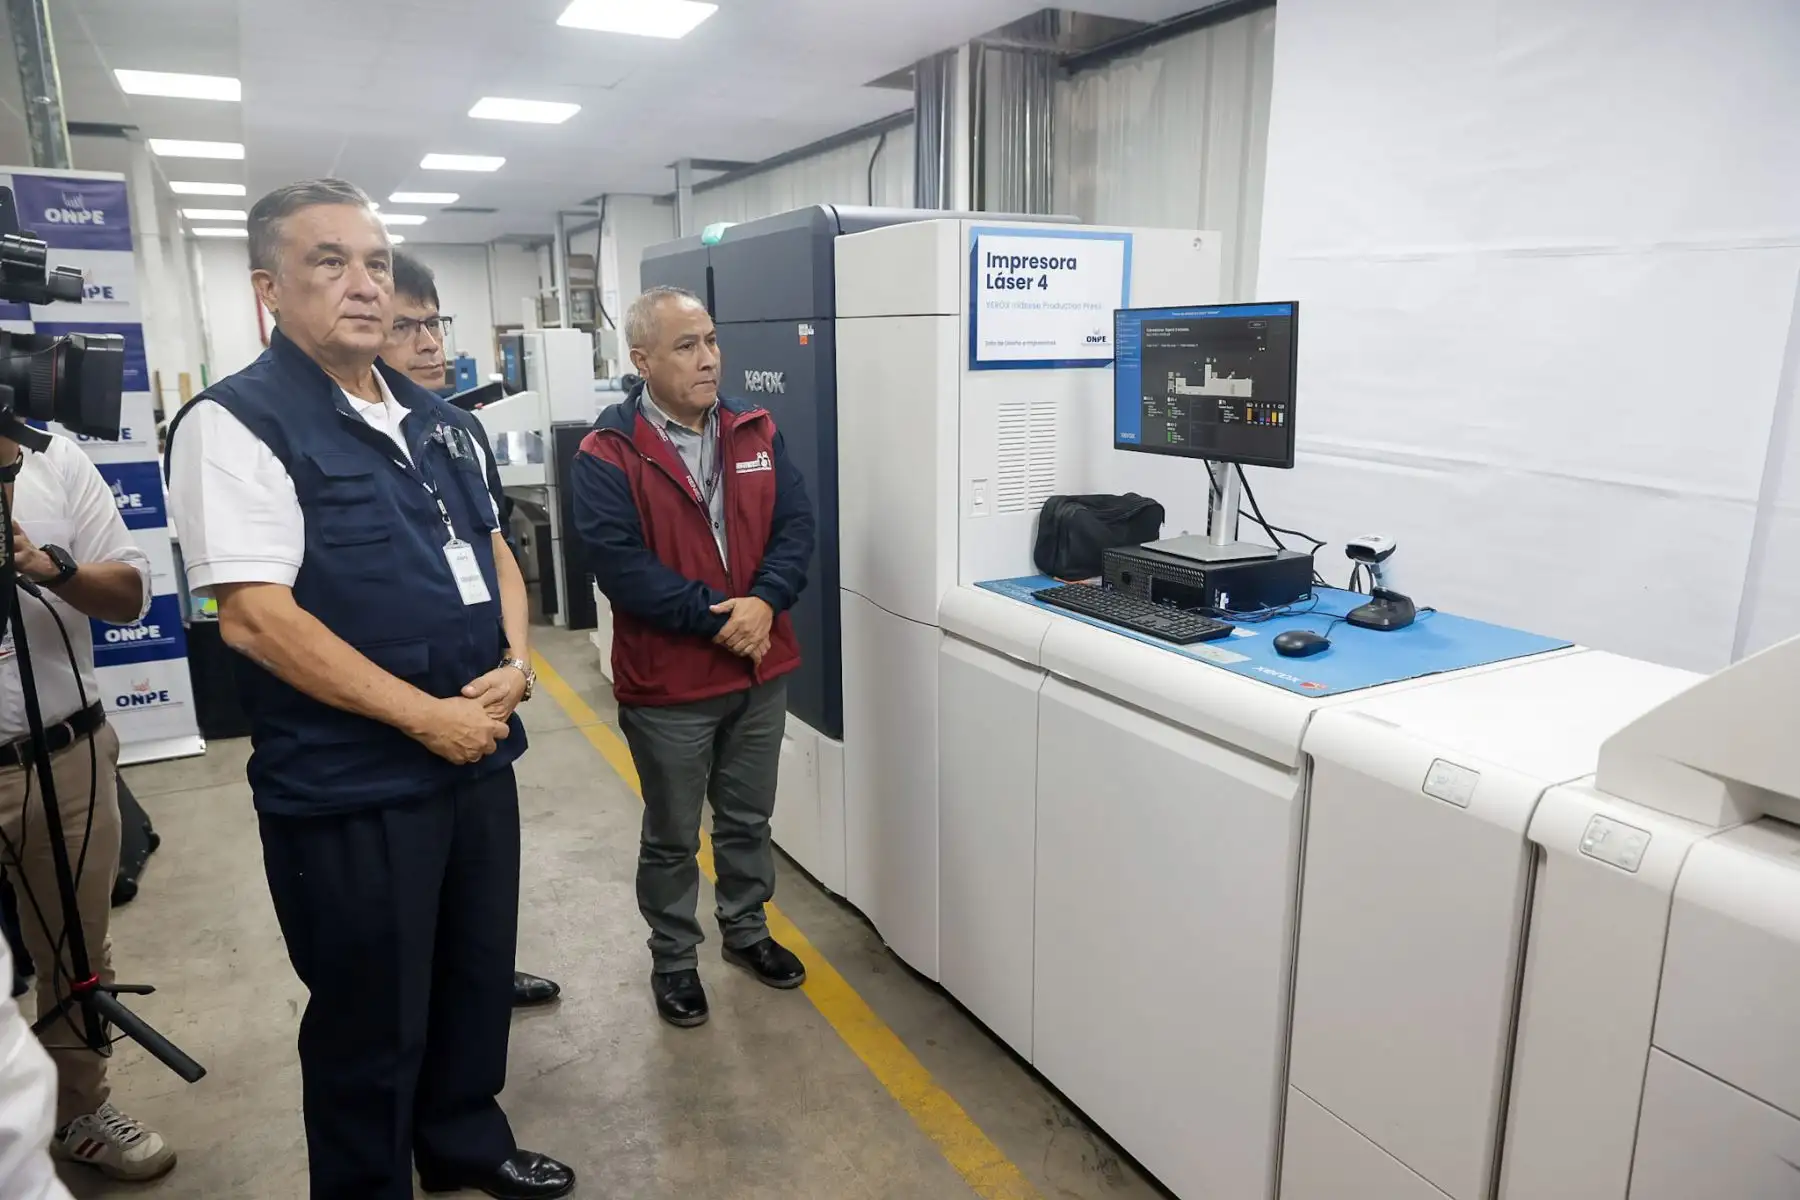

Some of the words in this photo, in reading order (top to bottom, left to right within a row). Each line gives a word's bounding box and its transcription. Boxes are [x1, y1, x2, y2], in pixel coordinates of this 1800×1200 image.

[44, 207, 105, 225] ONPE
[986, 252, 1077, 274] Impresora
[986, 272, 1034, 290] Láser
[1037, 274, 1048, 290] 4
[82, 286, 114, 299] PE
[1086, 335, 1107, 343] ONPE
[115, 493, 143, 508] PE
[104, 625, 161, 642] ONPE
[116, 690, 171, 707] ONPE
